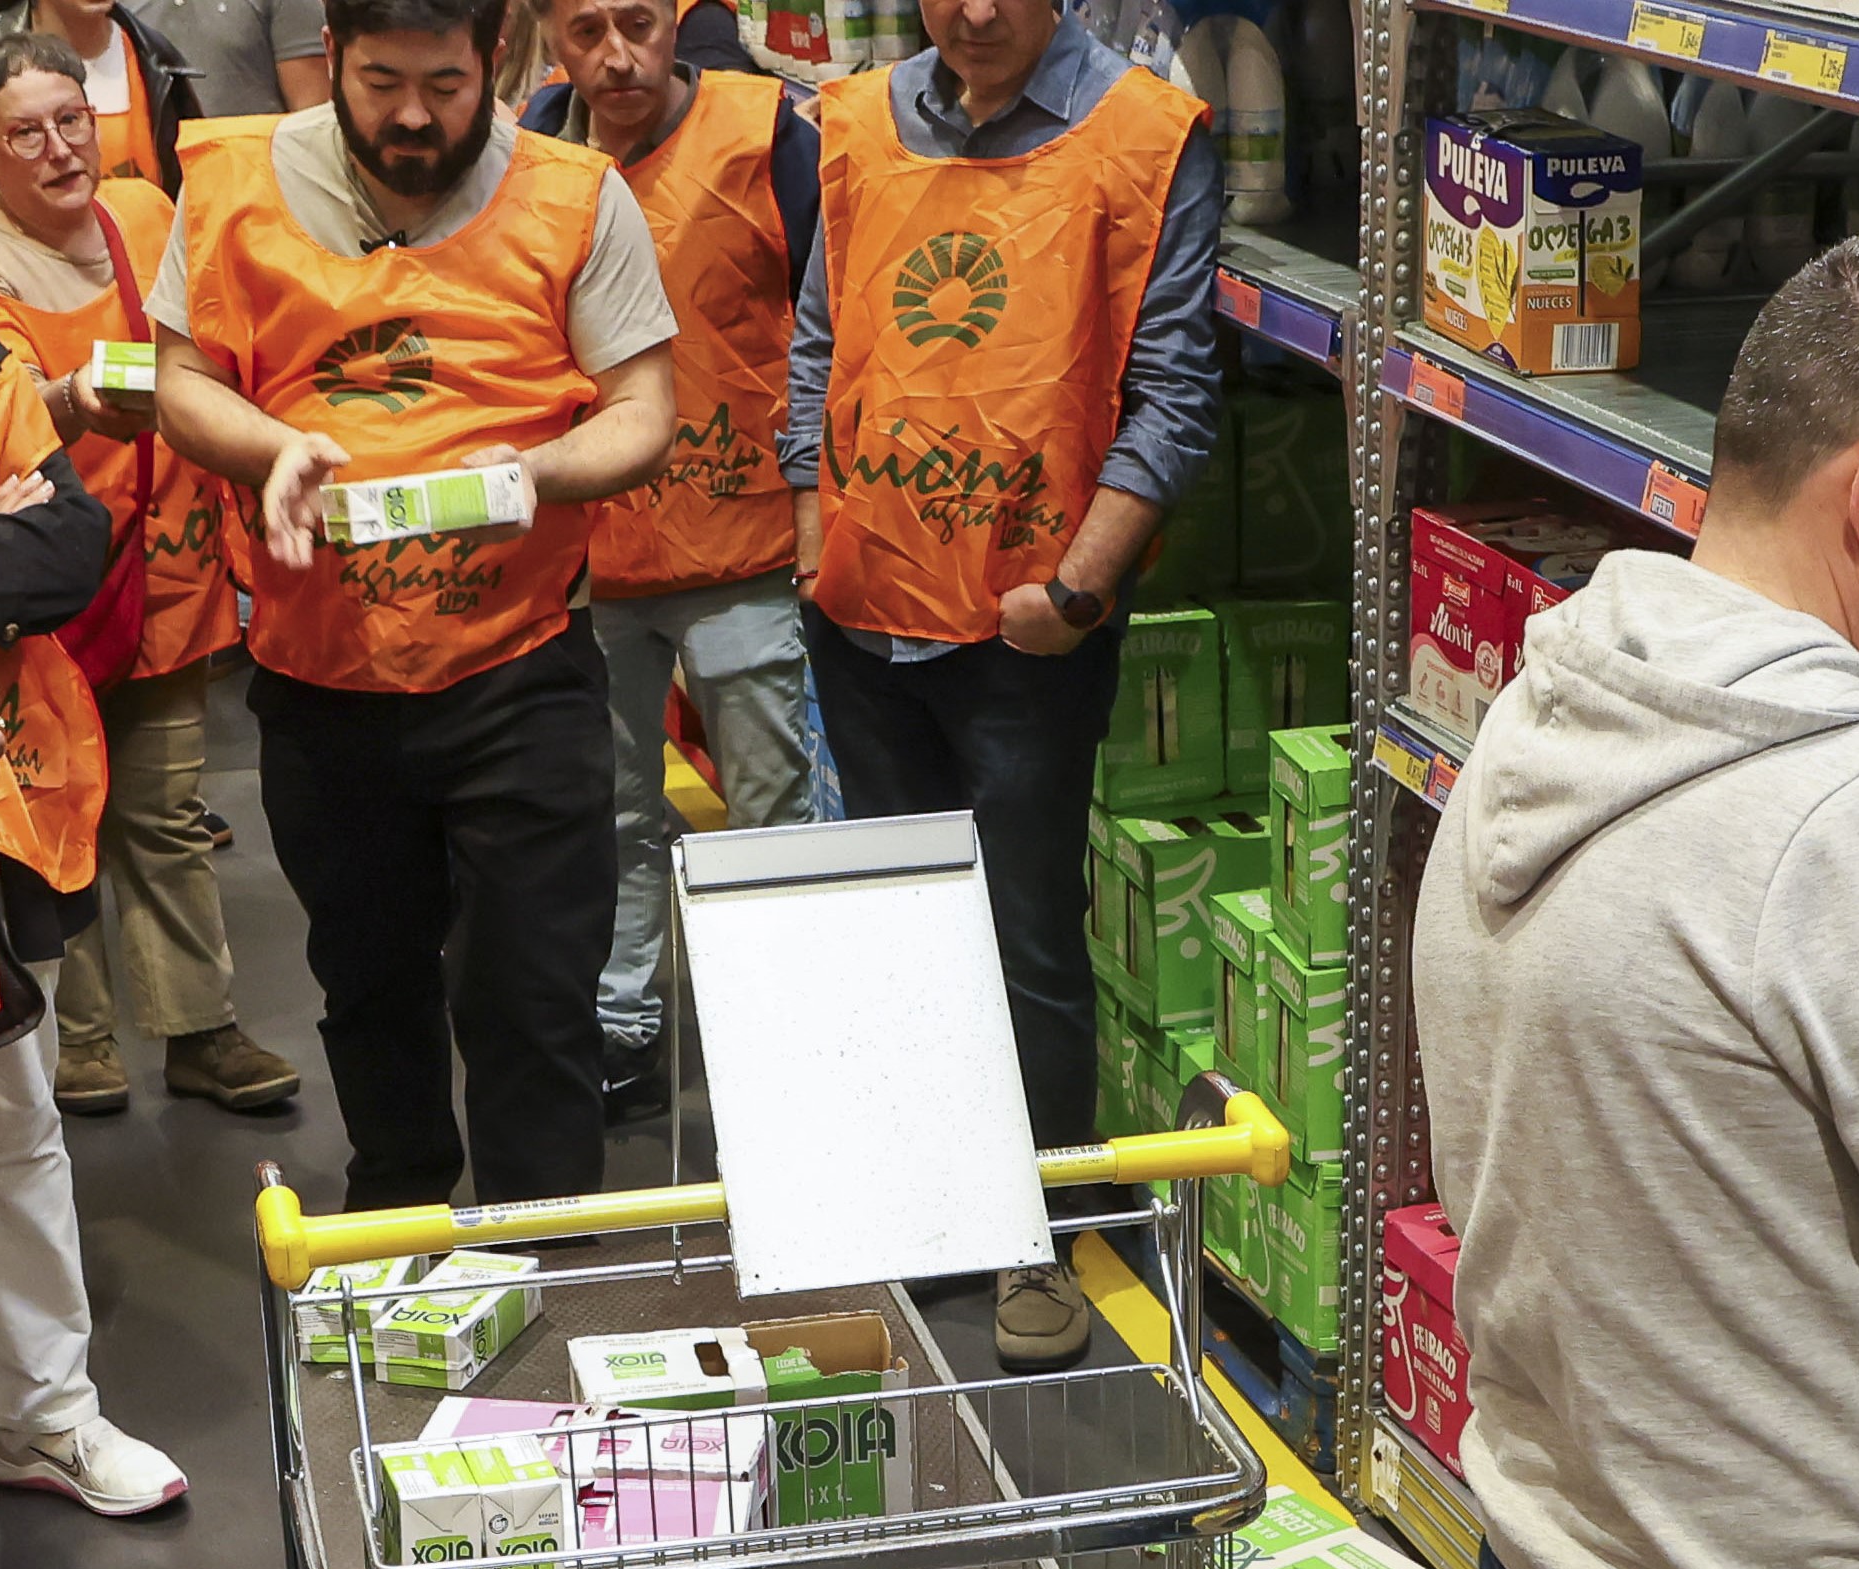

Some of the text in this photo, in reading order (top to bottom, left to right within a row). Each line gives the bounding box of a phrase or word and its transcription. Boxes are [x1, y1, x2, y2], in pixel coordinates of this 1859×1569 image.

[1439, 131, 1509, 205] PULEVA
[1547, 155, 1626, 178] PULEVA
[1527, 296, 1573, 310] NUECES
[385, 486, 410, 531] XOIA
[920, 497, 1068, 546] agrarias
[1650, 495, 1675, 520] OFERTA
[998, 523, 1035, 551] UPA
[340, 559, 503, 608] agrarias
[1506, 573, 1524, 594] 6x1L
[434, 590, 480, 616] UPA
[1429, 602, 1474, 653] Movit
[603, 1351, 668, 1369] XOIA
[1412, 1323, 1457, 1381] FEIRACO
[1413, 1355, 1457, 1404] DESNATADO
